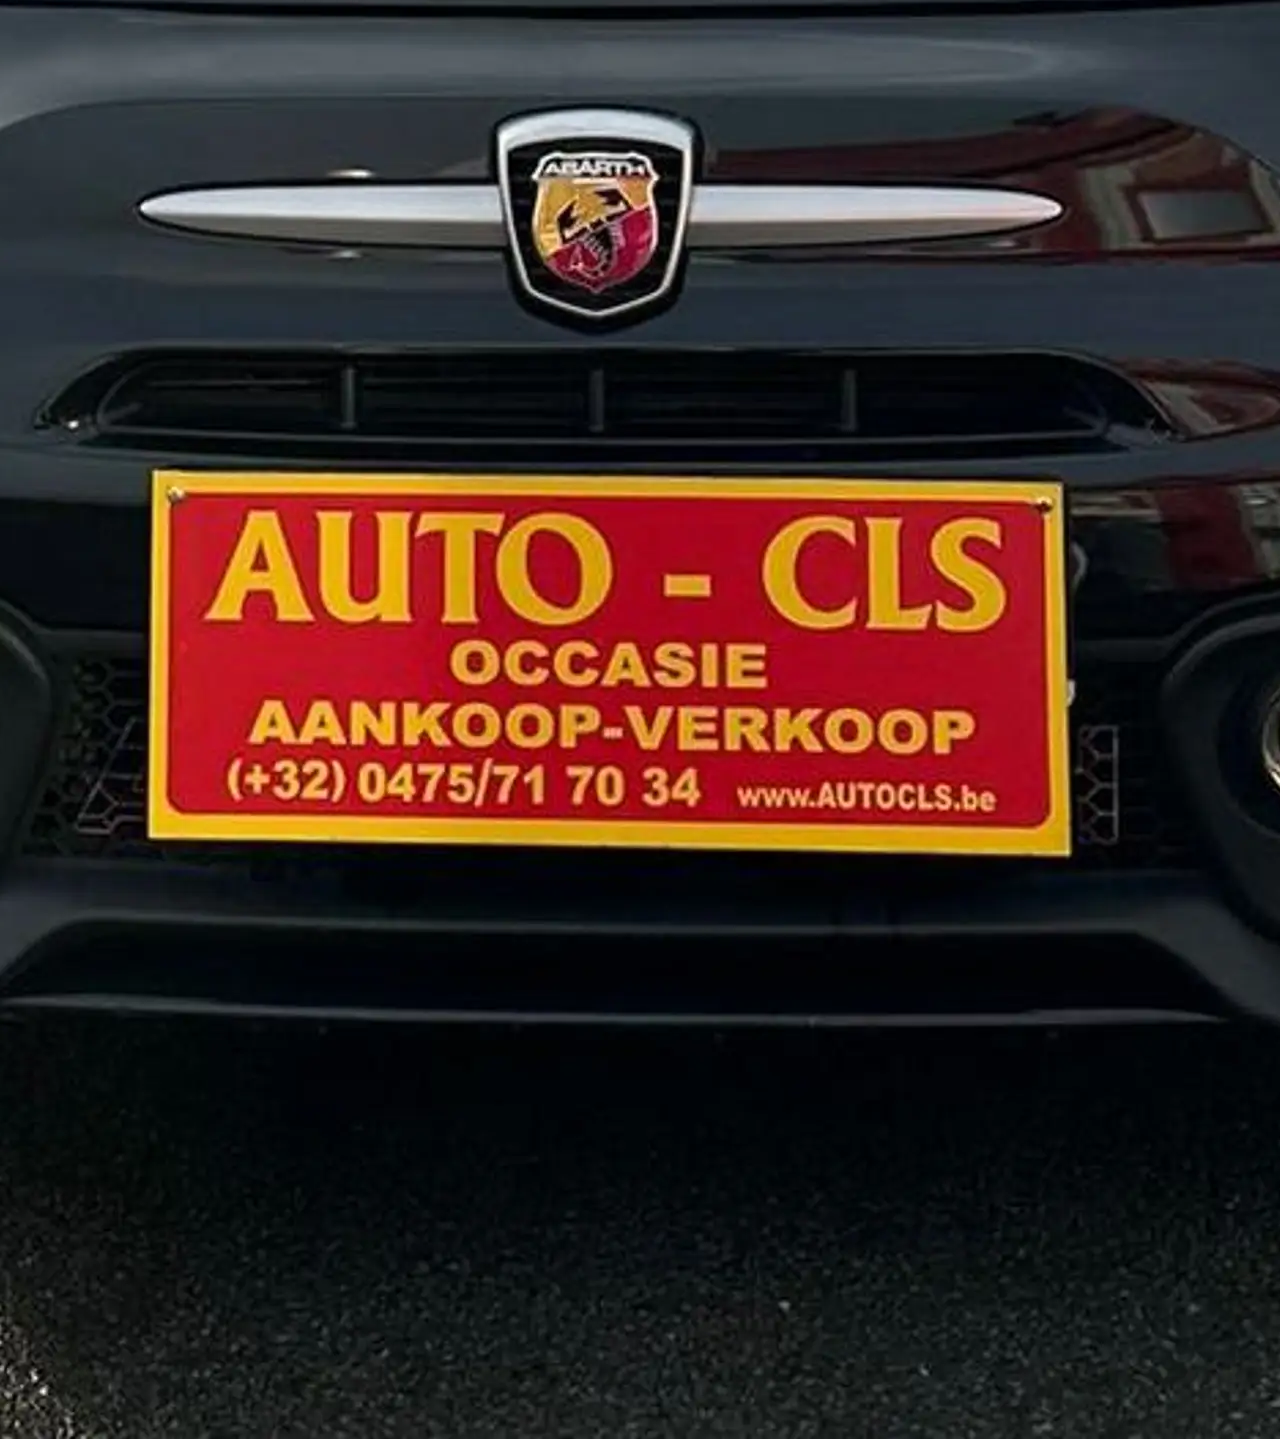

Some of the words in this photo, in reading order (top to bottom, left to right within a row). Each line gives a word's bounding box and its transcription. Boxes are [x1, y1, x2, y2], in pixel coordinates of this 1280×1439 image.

[203, 510, 614, 626] AUTO
[663, 573, 712, 598] -
[762, 514, 1007, 633] CLS
[449, 639, 768, 689] OCCASIE
[247, 699, 976, 756] AANKOOP-VERKOOP
[227, 758, 347, 802] (+32)
[357, 757, 546, 808] 0475/71
[565, 764, 625, 806] 70
[641, 765, 702, 808] 34
[736, 780, 998, 812] www.AUTOCLS.be
